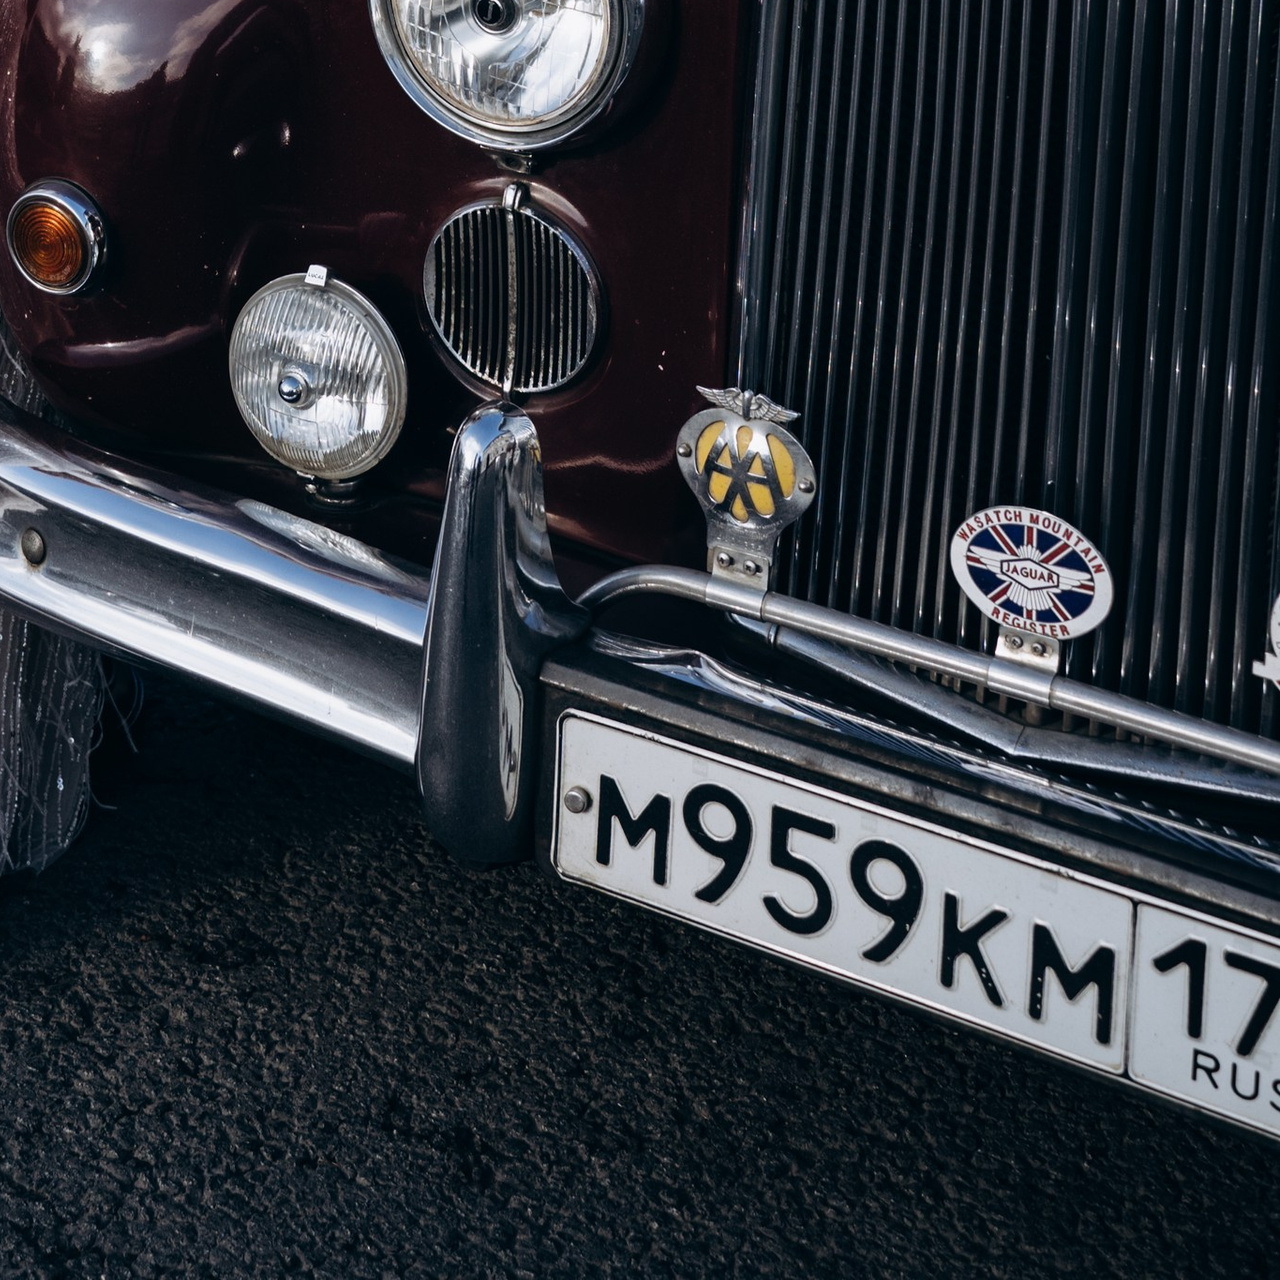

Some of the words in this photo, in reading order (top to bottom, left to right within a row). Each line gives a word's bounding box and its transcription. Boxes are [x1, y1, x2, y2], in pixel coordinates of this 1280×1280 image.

[700, 422, 790, 518] AA
[956, 509, 1023, 542] WASATCH
[1029, 513, 1105, 574] MOUNTAIN
[1005, 562, 1055, 584] JAGUAR
[991, 607, 1070, 637] REGISTER
